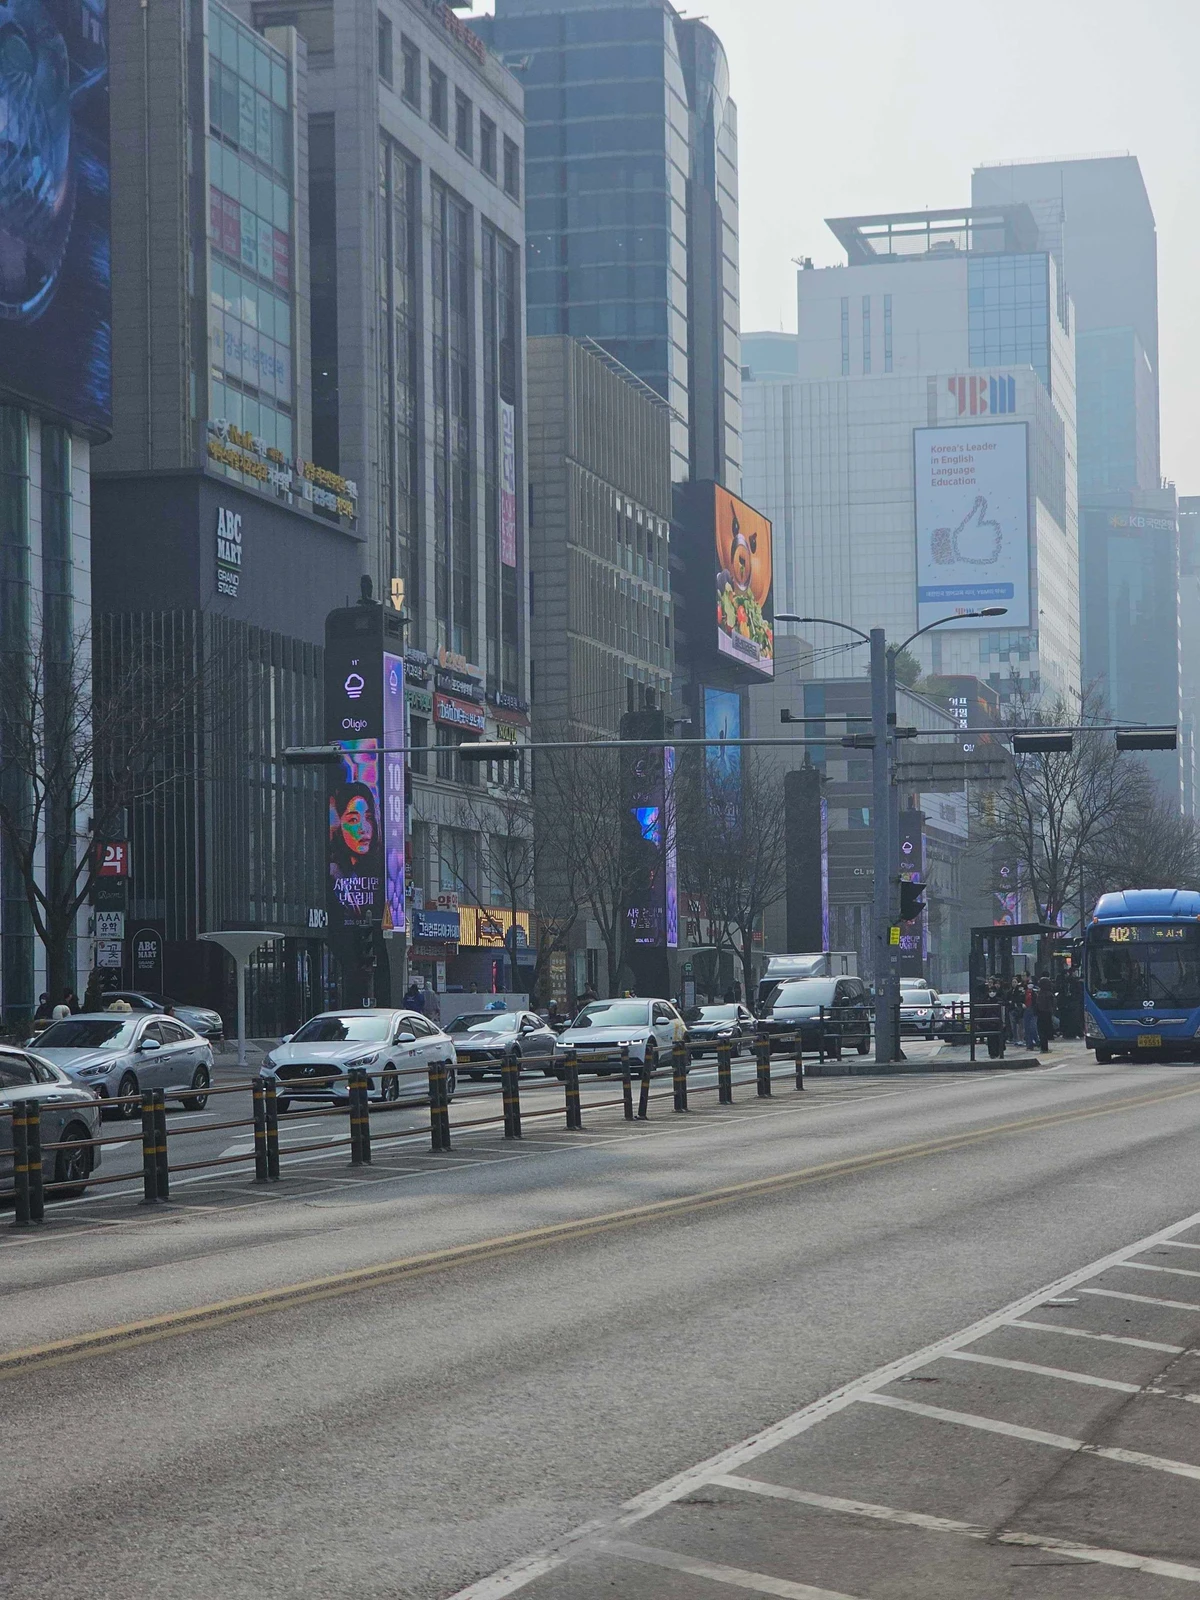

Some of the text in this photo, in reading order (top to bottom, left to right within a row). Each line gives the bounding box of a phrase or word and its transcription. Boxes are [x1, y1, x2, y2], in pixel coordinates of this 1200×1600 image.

[948, 374, 1016, 416] YBM
[931, 442, 997, 454] Korea's Leader
[931, 454, 974, 465] in English
[931, 466, 976, 477] Language
[931, 477, 976, 487] Education
[217, 507, 242, 543] ABC
[1129, 515, 1174, 531] KB 국민은행
[217, 538, 242, 565] MART
[217, 569, 239, 586] GRAND
[217, 581, 238, 597] STAGE
[342, 717, 368, 732] Oligio
[388, 763, 400, 792] 10
[103, 846, 123, 874] 약
[333, 876, 379, 891] 사랑한다면
[339, 891, 374, 906] 부드럽게
[100, 922, 117, 933] 유학
[1109, 927, 1130, 942] 402
[107, 944, 119, 959] 꽃
[138, 941, 157, 951] ABC
